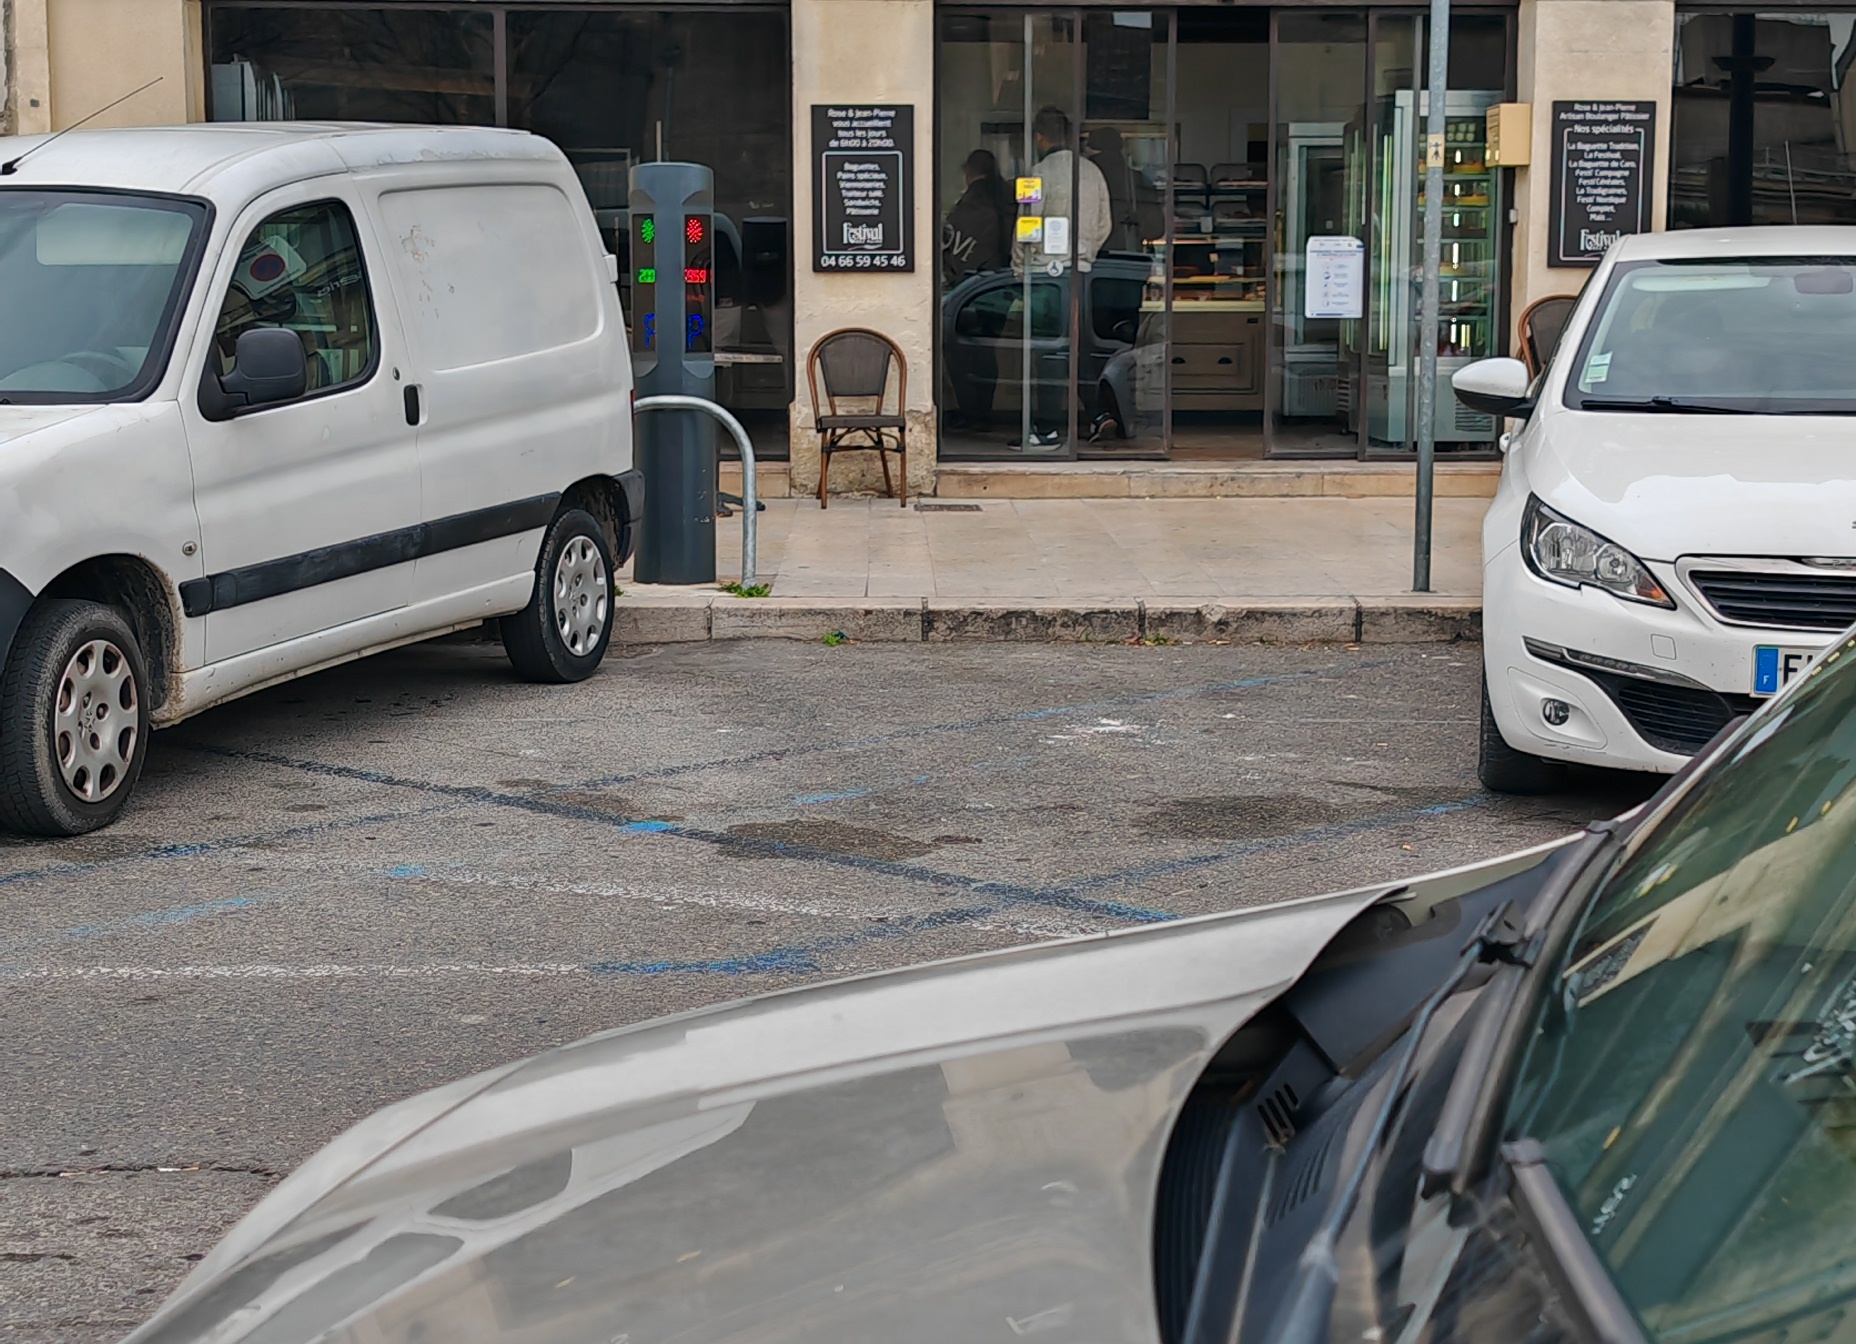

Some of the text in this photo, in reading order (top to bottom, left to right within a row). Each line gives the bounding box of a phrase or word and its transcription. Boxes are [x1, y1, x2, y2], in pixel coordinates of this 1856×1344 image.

[843, 222, 883, 244] Festival
[820, 255, 836, 268] 04
[855, 255, 871, 267] 59
[872, 255, 889, 267] 45
